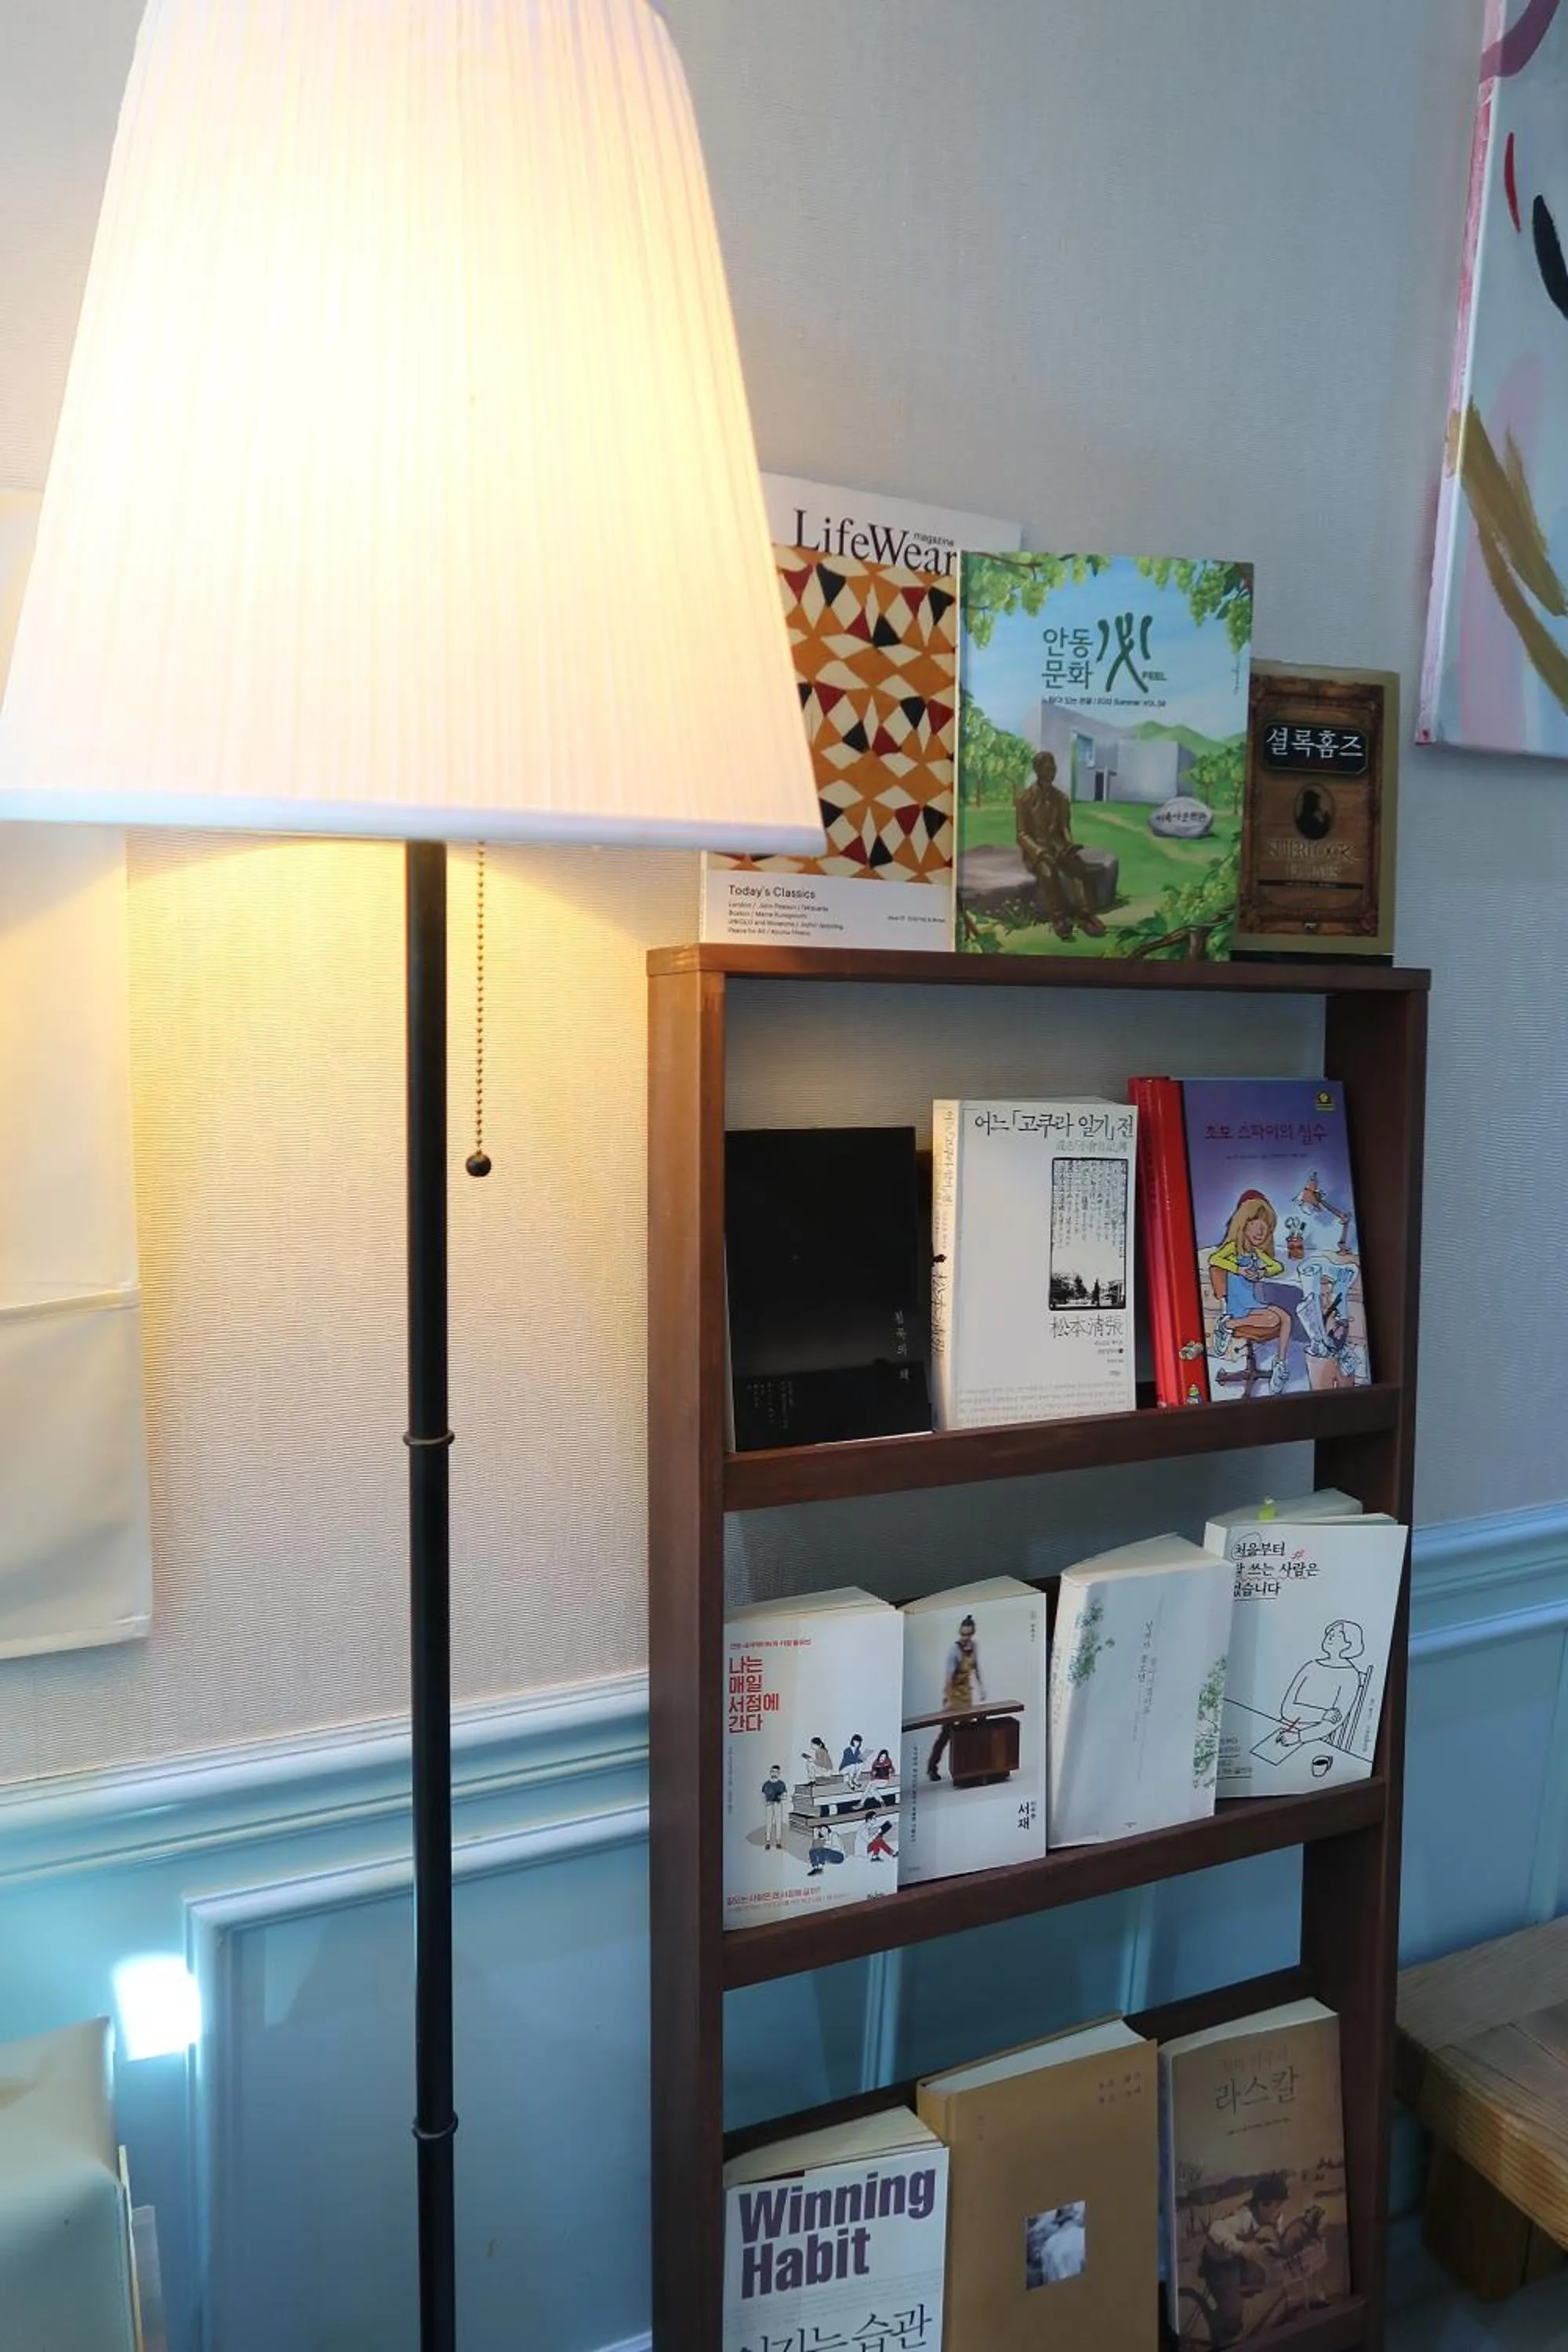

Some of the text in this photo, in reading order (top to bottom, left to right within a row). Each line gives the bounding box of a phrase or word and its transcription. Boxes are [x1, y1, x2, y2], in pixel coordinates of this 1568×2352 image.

[793, 508, 956, 575] LifeWear
[913, 532, 955, 547] magazine
[1043, 626, 1094, 658] 안동
[1041, 659, 1094, 690] 문화
[1266, 727, 1364, 760] 셜록홈즈
[728, 884, 816, 899] Today's Classics
[975, 1111, 1010, 1136] 어느
[1235, 1541, 1286, 1557] 처음부터
[1247, 1562, 1275, 1577] 쓰는
[1279, 1561, 1321, 1577] 사람은
[728, 1655, 764, 1674] 나는
[728, 1675, 762, 1693] 매일
[728, 1693, 779, 1713] 서점에
[728, 1713, 764, 1733] 간다
[1215, 2064, 1301, 2115] 라스칼
[738, 2169, 936, 2245] Winning
[741, 2227, 870, 2299] Habit
[851, 2303, 933, 2352] 습관
